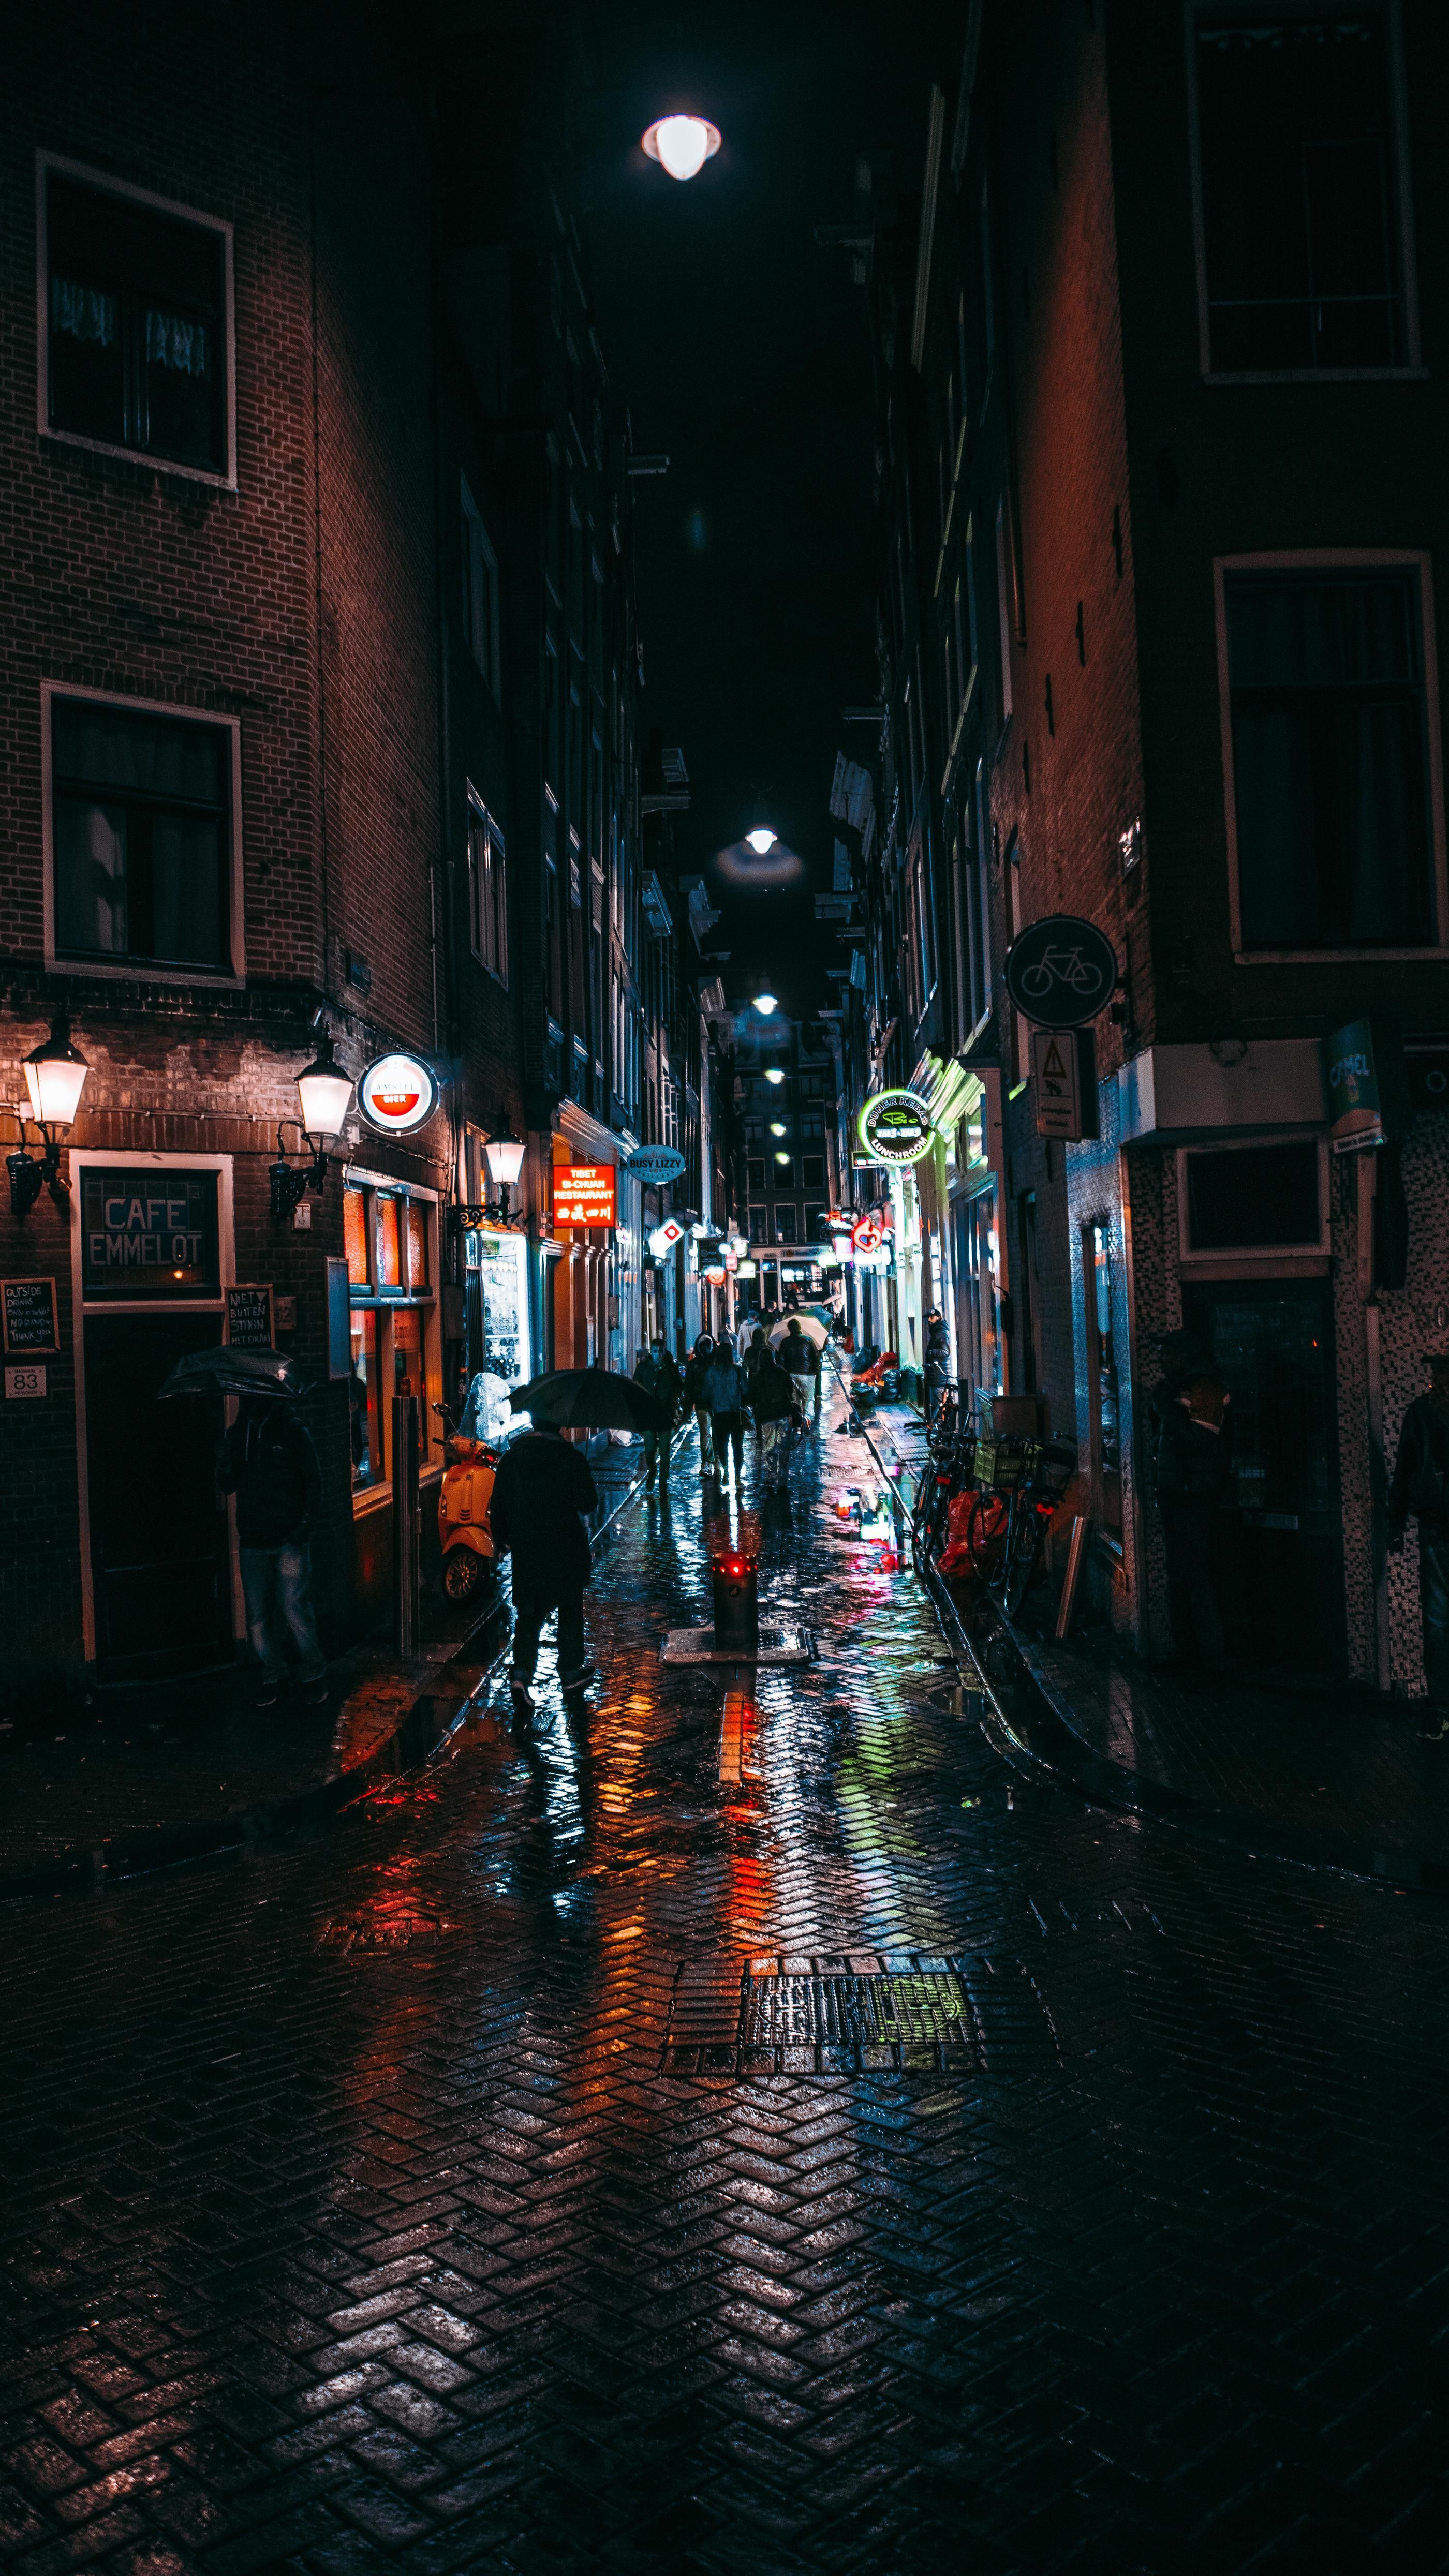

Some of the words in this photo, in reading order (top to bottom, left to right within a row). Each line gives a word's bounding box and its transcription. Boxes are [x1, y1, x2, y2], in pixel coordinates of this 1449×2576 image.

[383, 1095, 406, 1103] BIER
[871, 1136, 928, 1159] LUNCHROOM
[630, 1159, 654, 1168] BUSY
[656, 1159, 681, 1168] LIZZY
[570, 1169, 597, 1178] TIBET
[562, 1180, 605, 1189] SI-CHUAN
[554, 1190, 614, 1199] RESTAURANT
[105, 1198, 186, 1230] CAFE
[88, 1233, 202, 1267] EMMELOT
[6, 1286, 42, 1297] OUTSIDE
[7, 1298, 33, 1307] DRINKS
[230, 1291, 255, 1307] NIET
[230, 1304, 265, 1318] BUITEN
[230, 1319, 264, 1332] STAAN
[14, 1374, 38, 1390] 83
